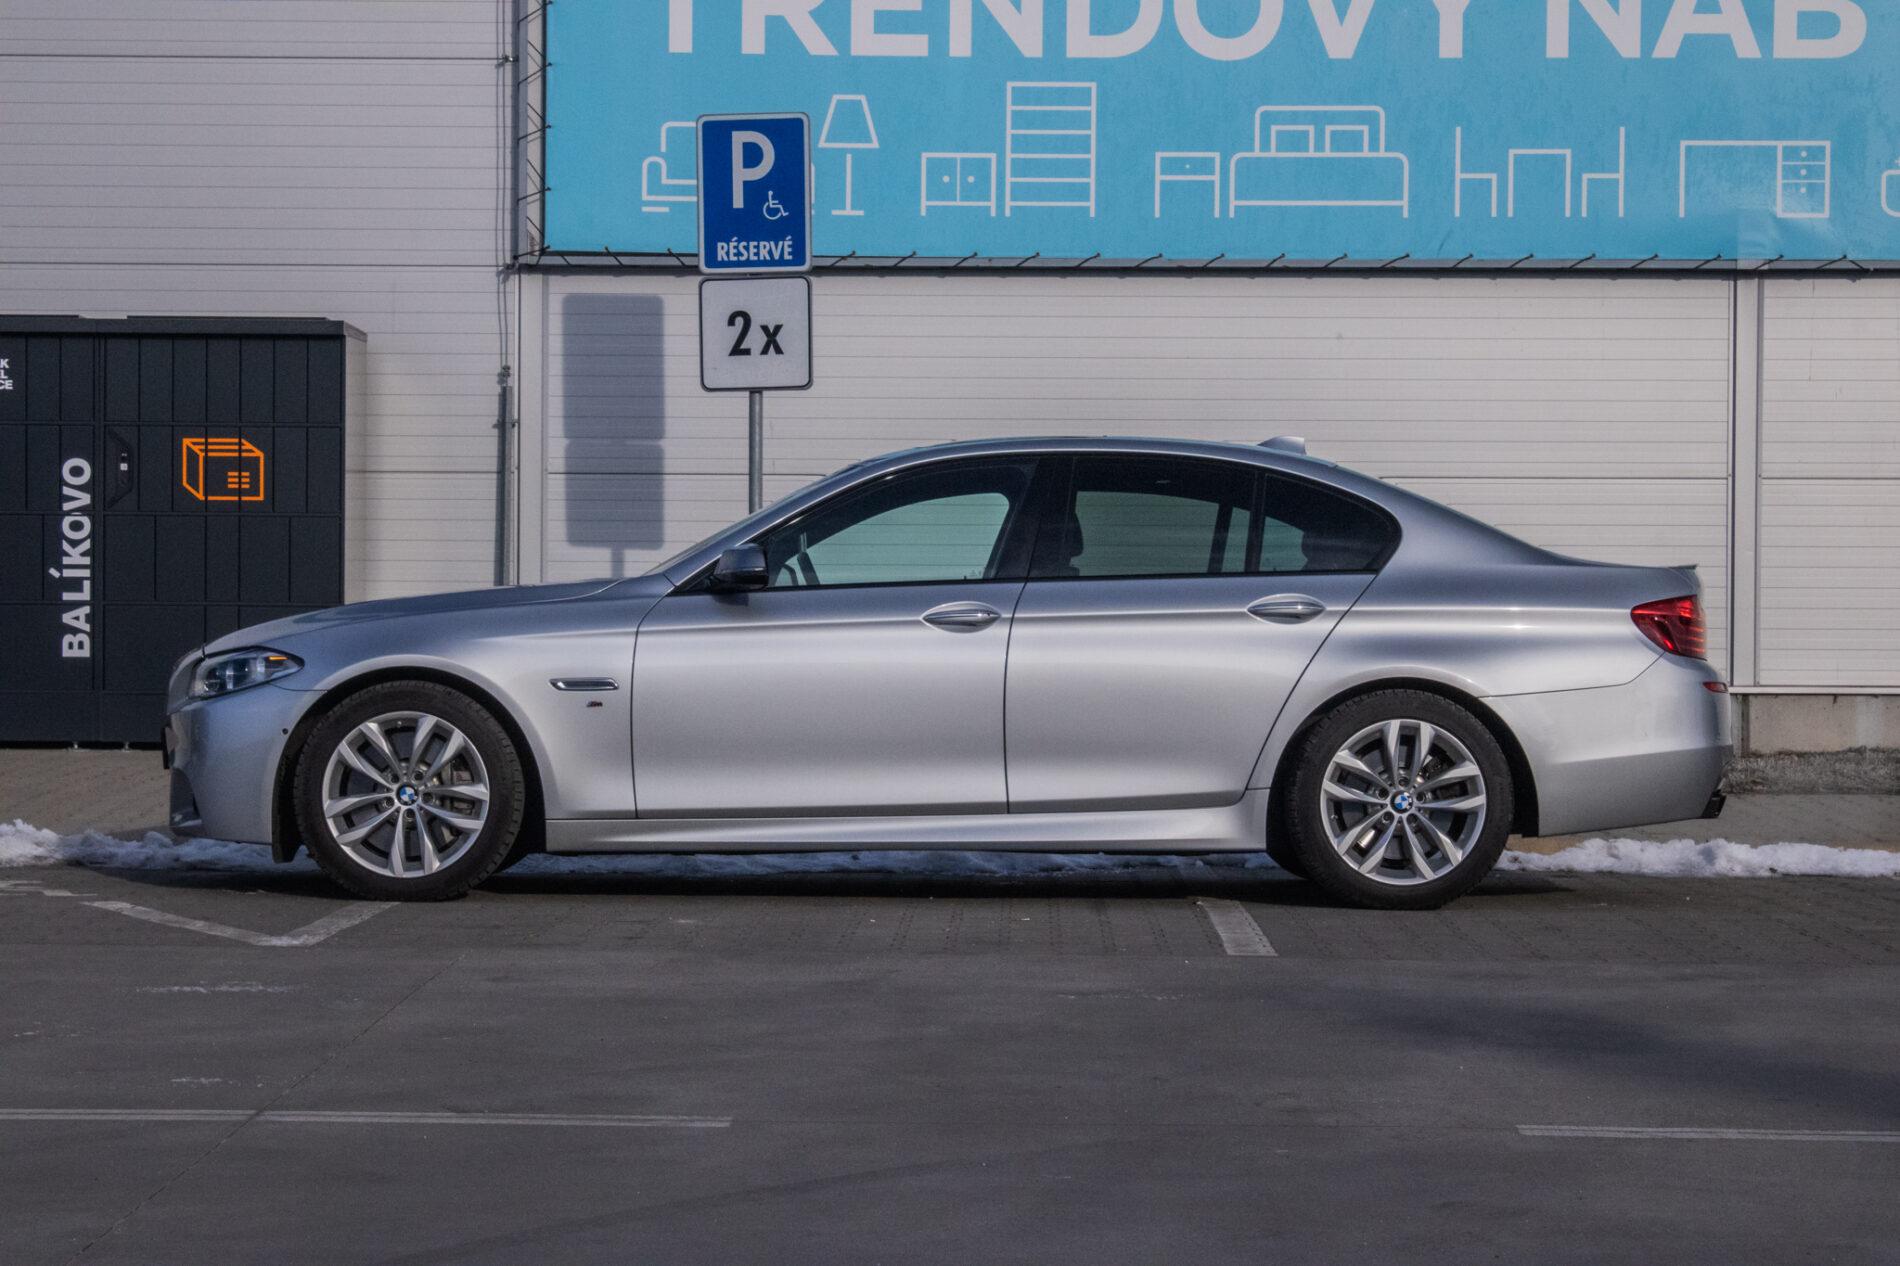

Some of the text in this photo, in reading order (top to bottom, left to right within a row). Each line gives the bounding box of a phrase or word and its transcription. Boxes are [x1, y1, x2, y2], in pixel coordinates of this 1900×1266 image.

[731, 130, 775, 209] P
[717, 235, 793, 262] RÉSERVÉ
[49, 456, 92, 658] BALÍKOVO
